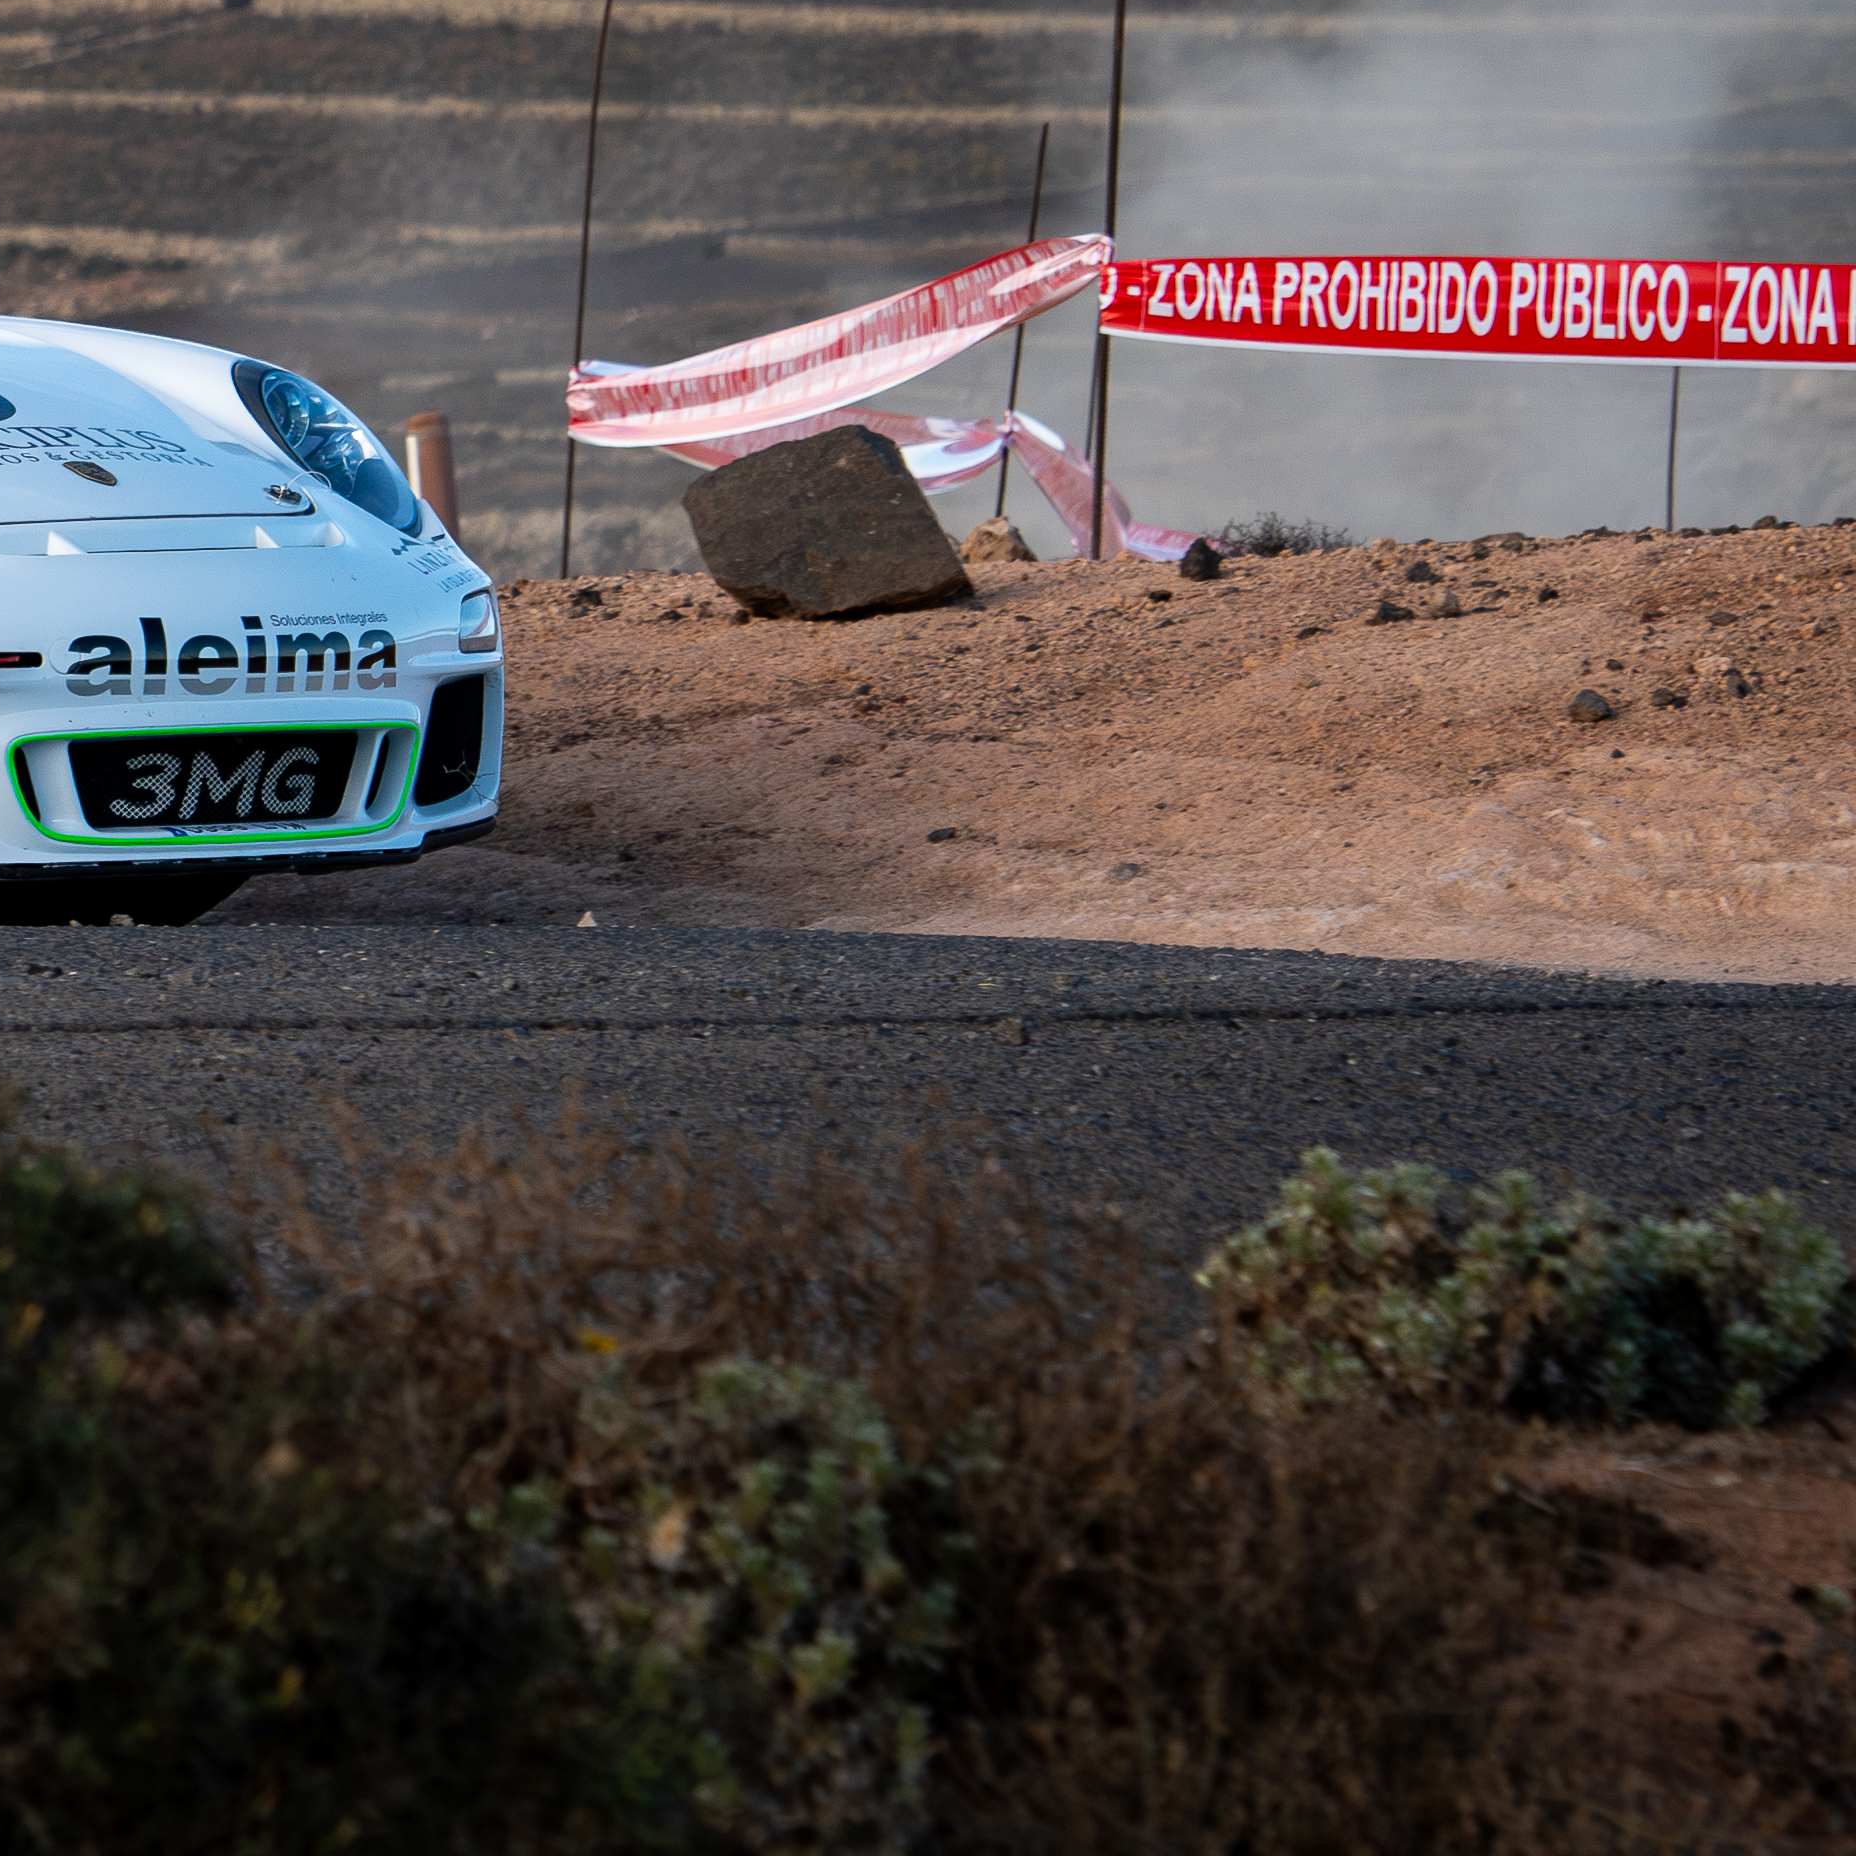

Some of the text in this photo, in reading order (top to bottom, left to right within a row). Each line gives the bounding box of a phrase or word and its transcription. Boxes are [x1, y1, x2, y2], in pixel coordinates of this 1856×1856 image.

[1147, 261, 1263, 325] ZONA
[1272, 259, 1499, 337] PROHIBIDO
[1508, 261, 1689, 342] PUBLICO
[1721, 265, 1839, 345] ZONA
[65, 616, 398, 697] aleima
[269, 610, 389, 628] Soluciones Integrales
[108, 746, 321, 821] 3MG
